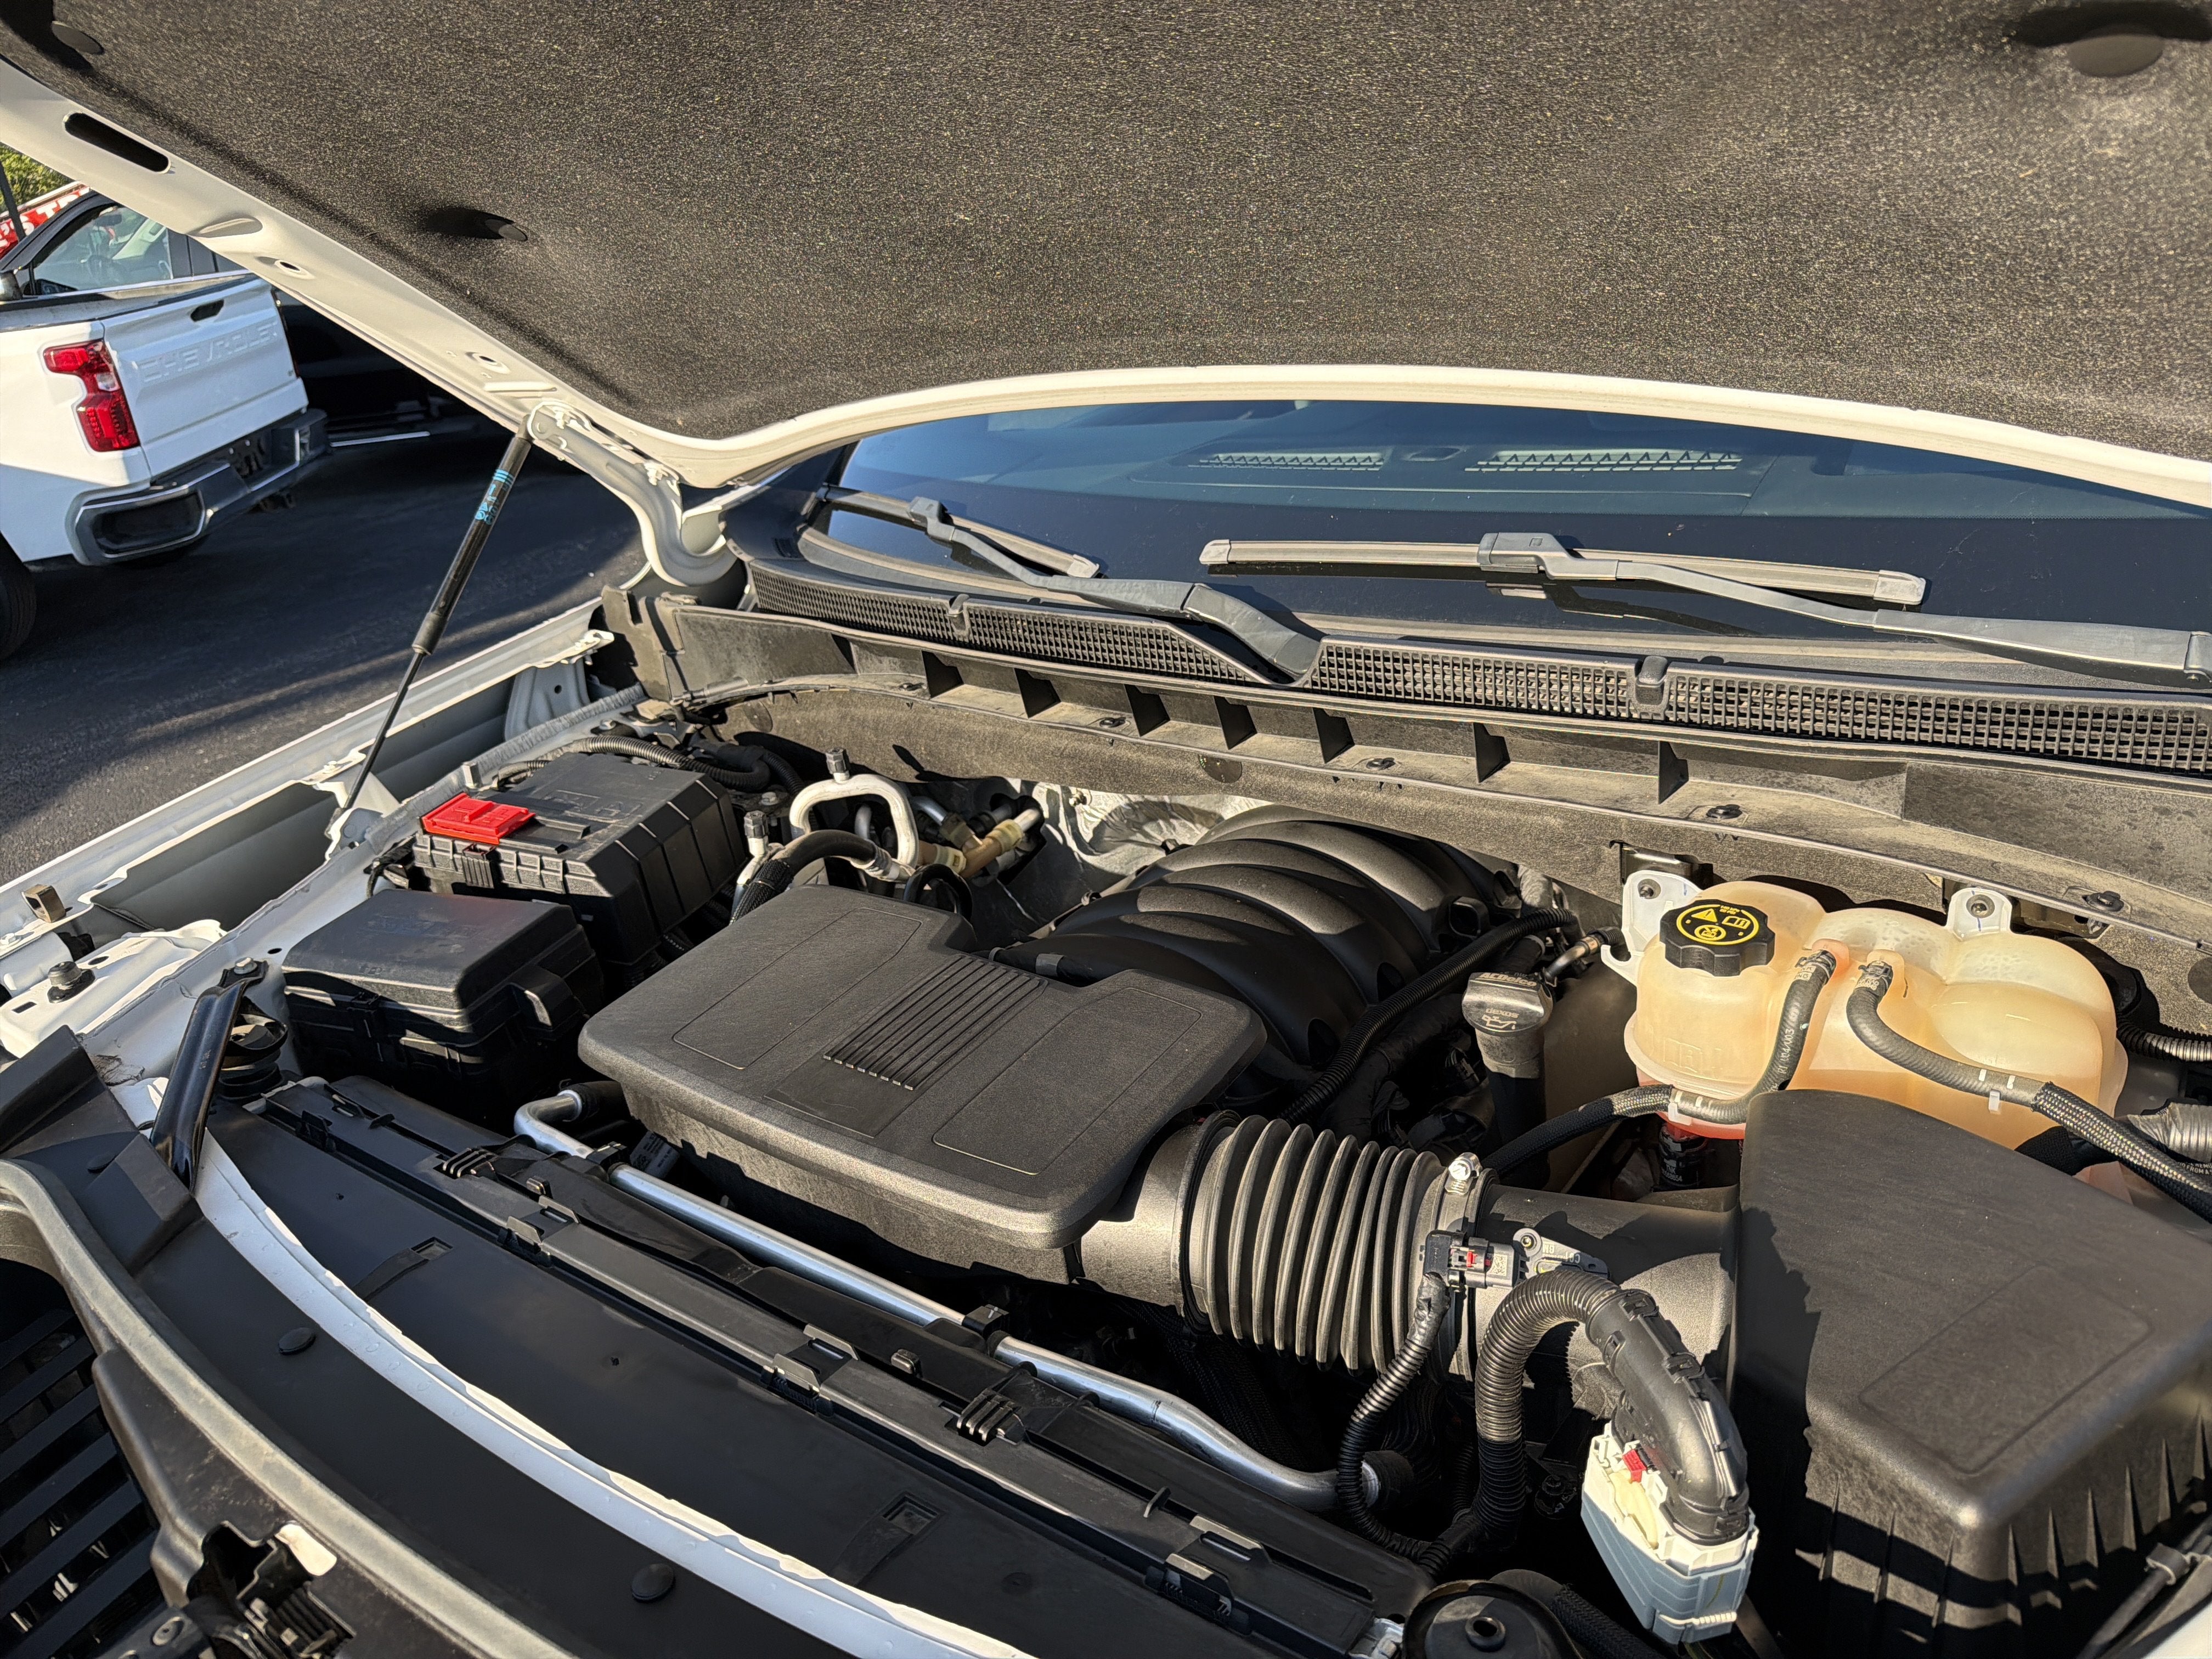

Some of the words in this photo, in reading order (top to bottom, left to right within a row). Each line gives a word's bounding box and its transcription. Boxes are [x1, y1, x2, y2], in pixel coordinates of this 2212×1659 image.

[1478, 972, 1537, 986] ACDelco
[1485, 1007, 1520, 1019] dexos
[2186, 1165, 2204, 1174] FROM
